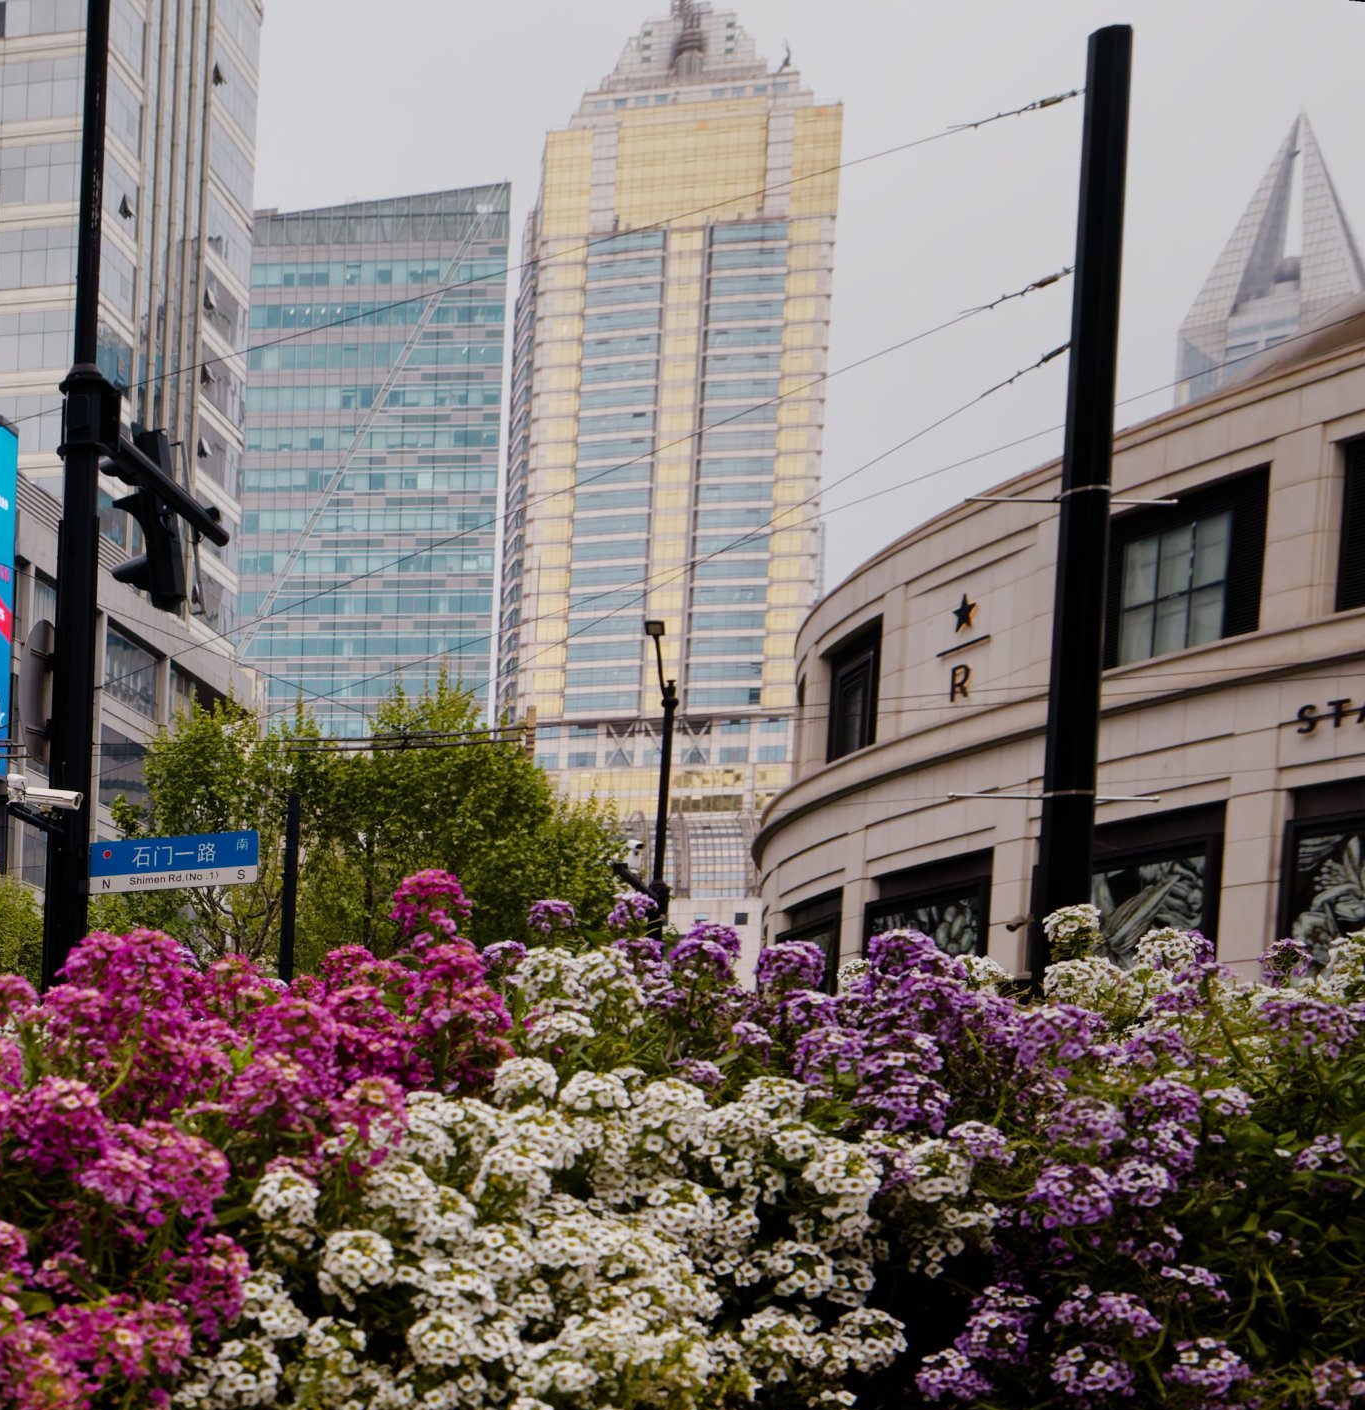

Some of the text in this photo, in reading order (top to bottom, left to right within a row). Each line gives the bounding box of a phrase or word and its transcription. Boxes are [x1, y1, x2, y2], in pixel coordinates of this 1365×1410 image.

[950, 664, 971, 703] R
[236, 838, 249, 851] 南
[132, 842, 217, 869] 石门一路
[129, 872, 166, 885] Shimen
[236, 870, 246, 880] S
[102, 879, 111, 889] N
